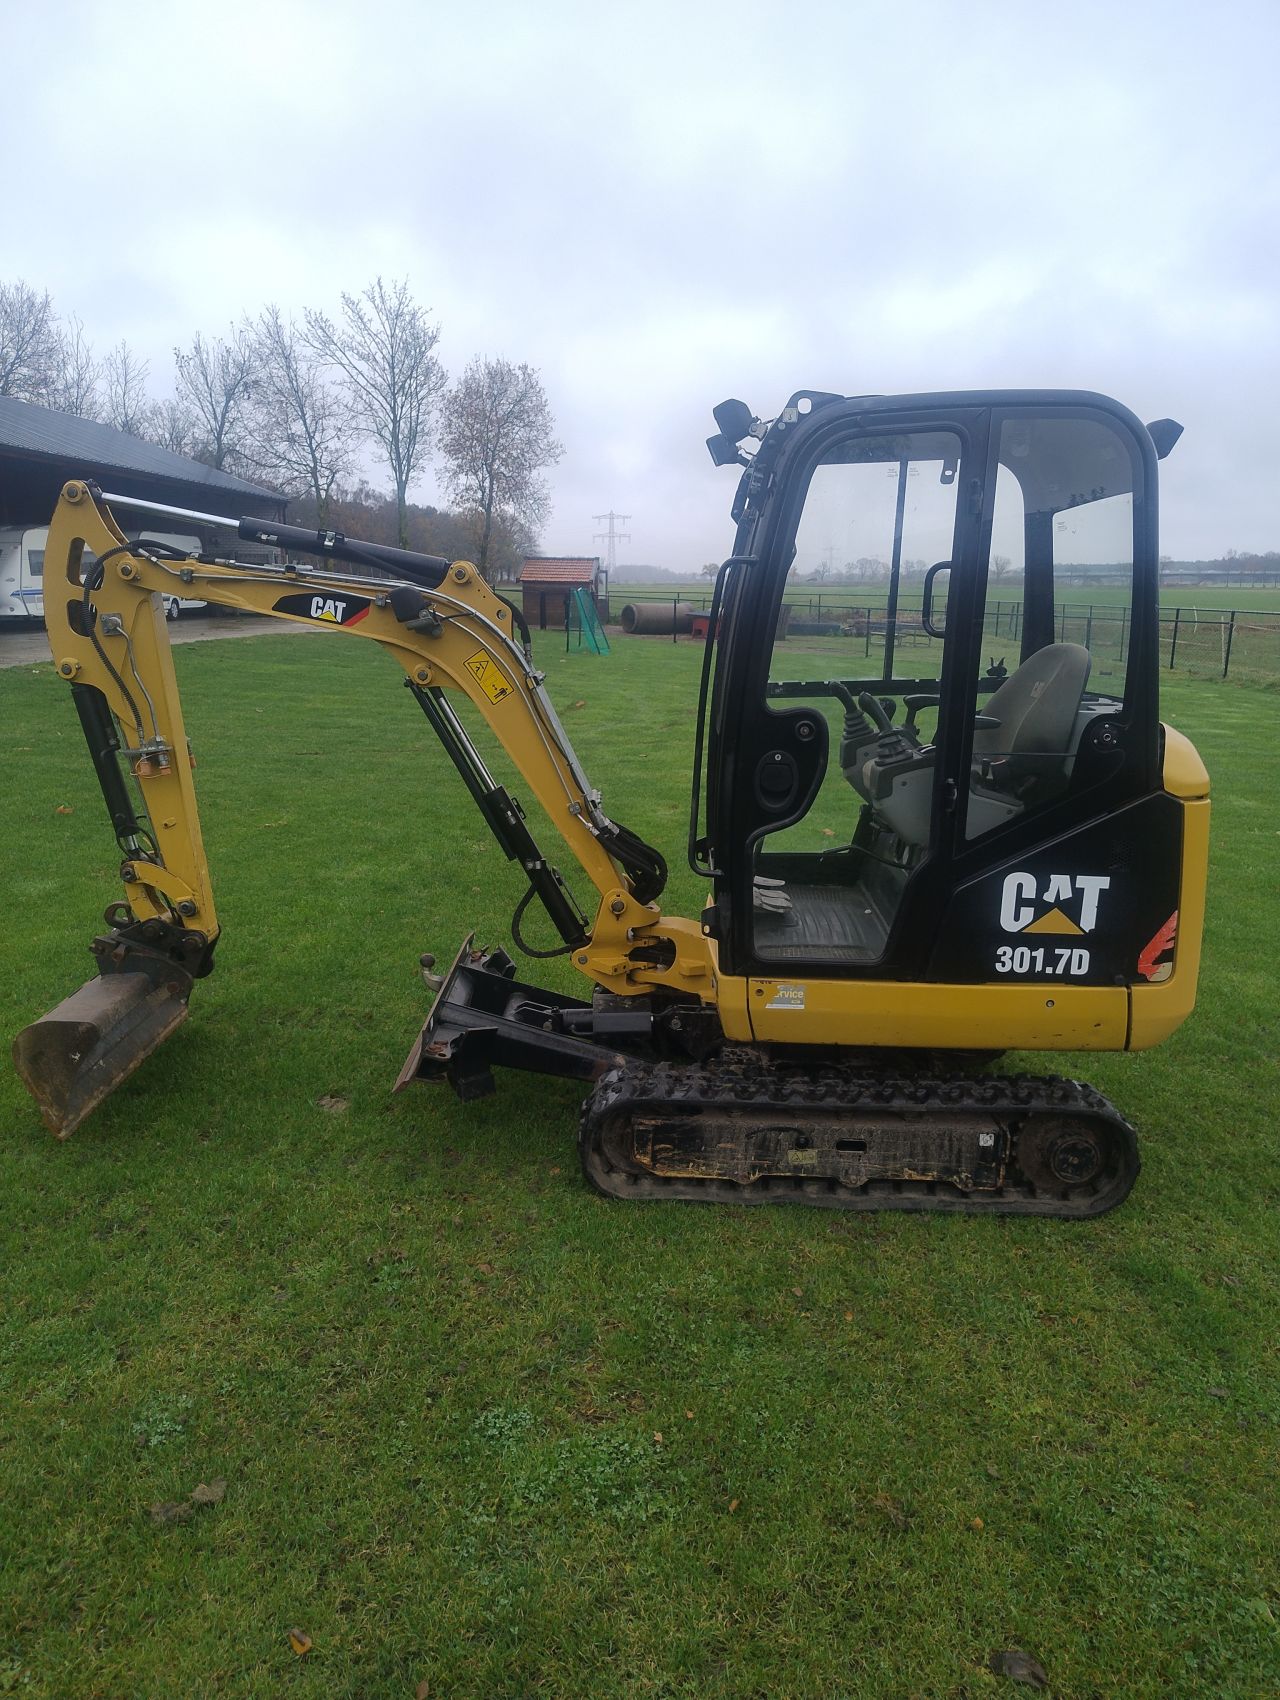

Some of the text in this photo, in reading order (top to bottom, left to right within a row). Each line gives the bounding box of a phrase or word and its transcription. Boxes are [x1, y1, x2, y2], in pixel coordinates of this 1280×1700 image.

[310, 596, 346, 623] CAT
[1000, 871, 1110, 933] CAT
[995, 946, 1090, 975] 301.7D
[774, 988, 804, 999] rvice
